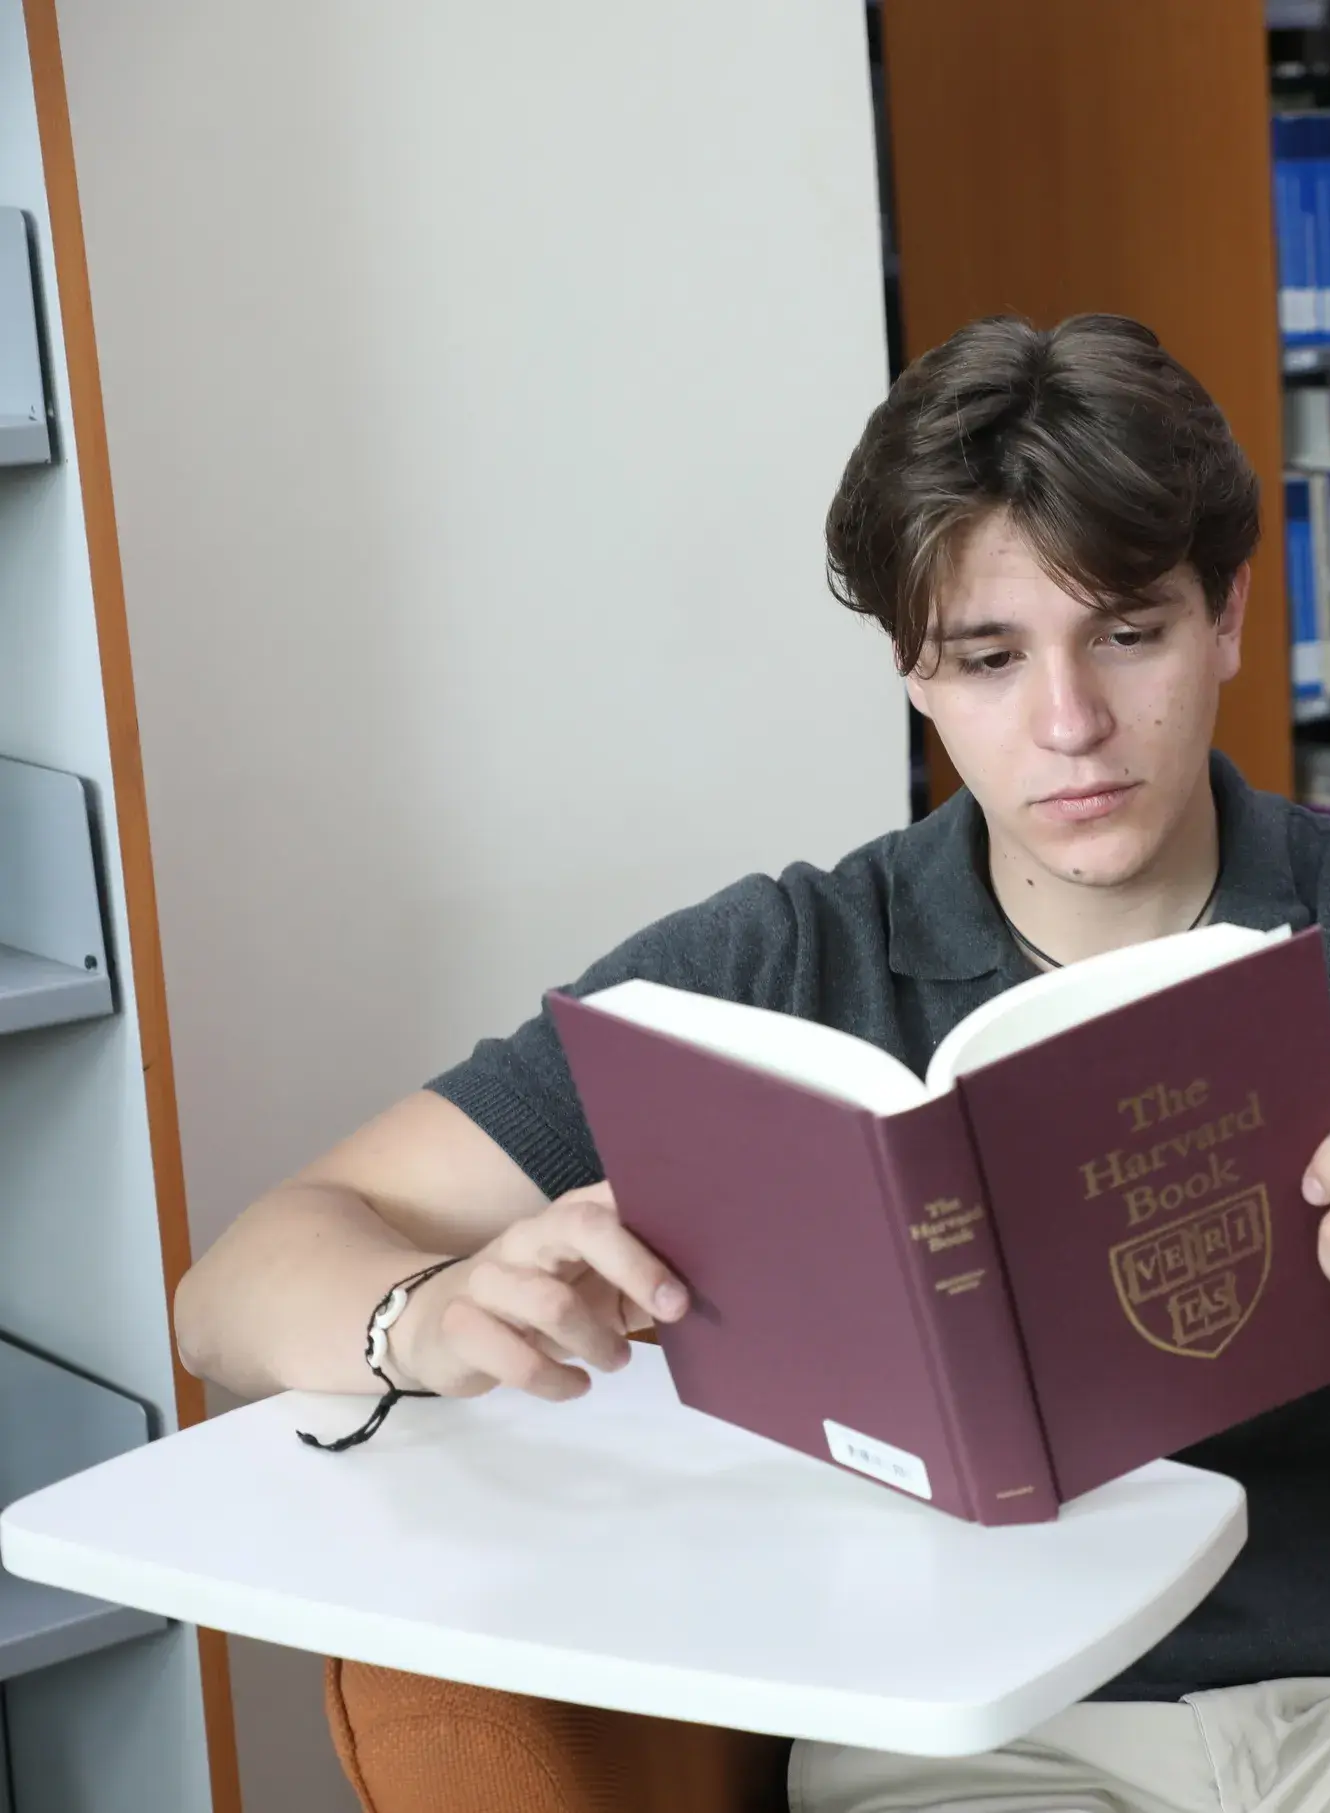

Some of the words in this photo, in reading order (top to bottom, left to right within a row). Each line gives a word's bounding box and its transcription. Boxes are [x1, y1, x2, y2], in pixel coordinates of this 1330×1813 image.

[1116, 1077, 1210, 1134] The
[1078, 1088, 1267, 1201] Harvard
[1122, 1151, 1241, 1227] Book
